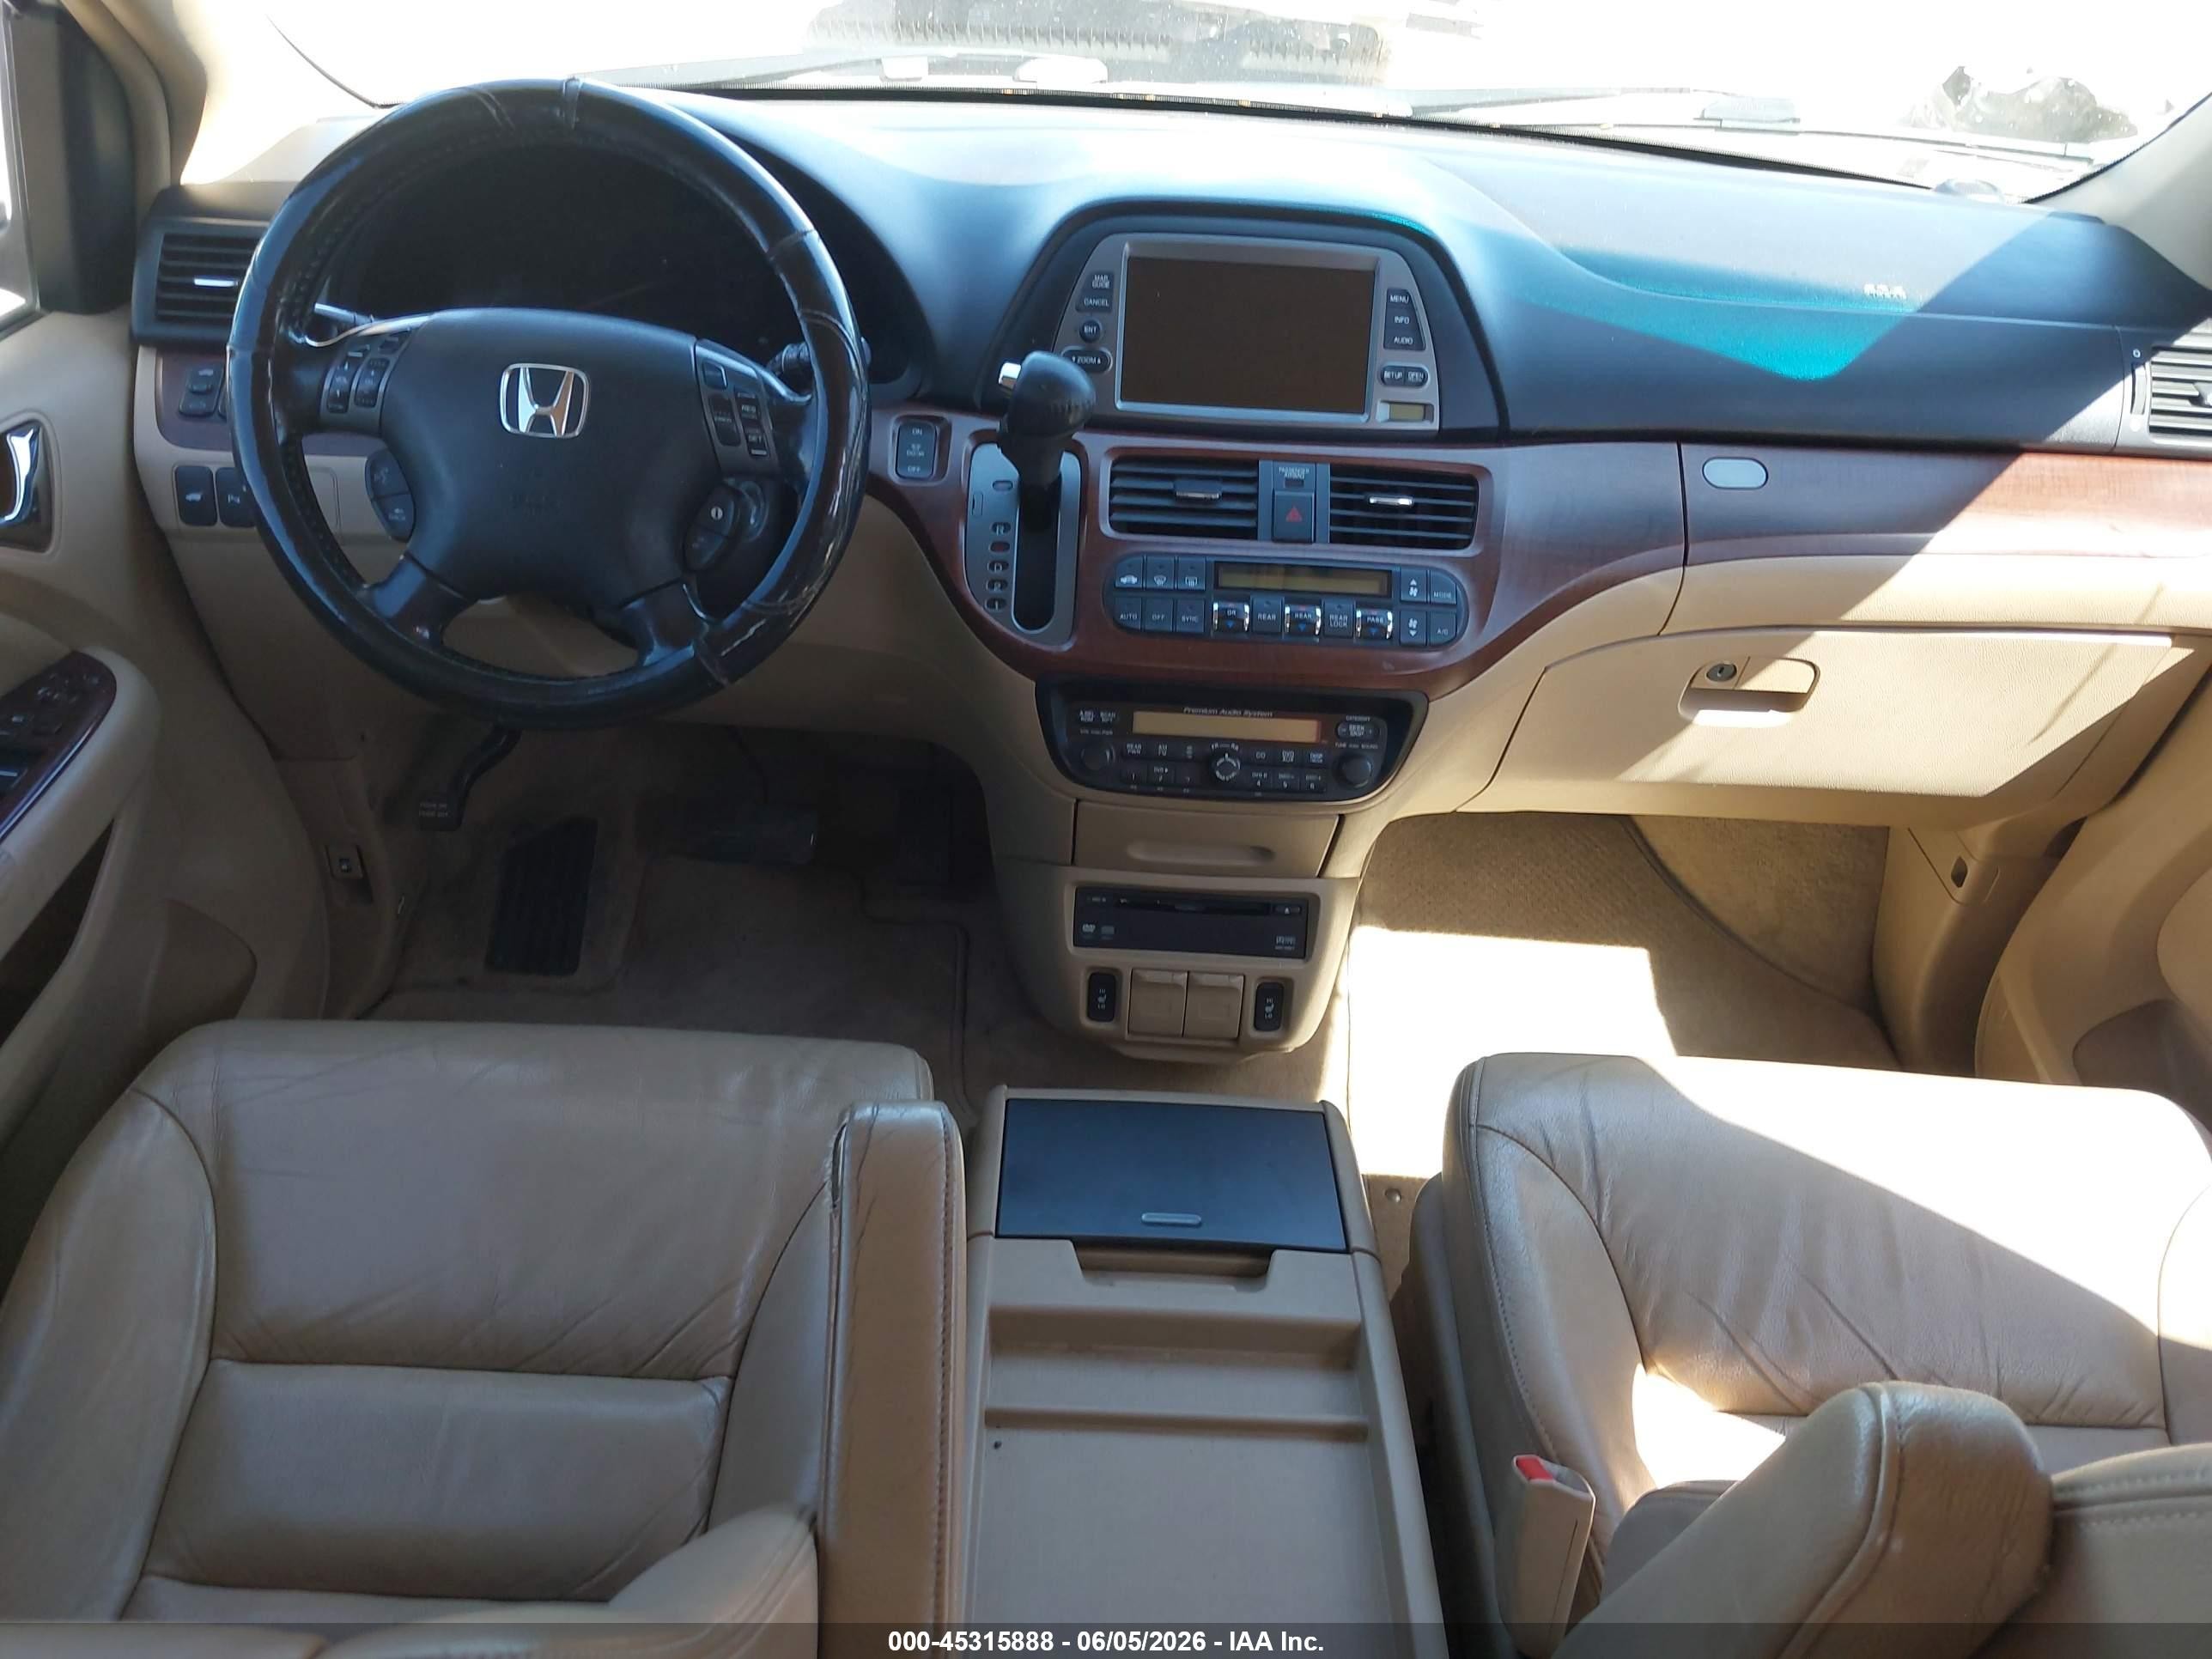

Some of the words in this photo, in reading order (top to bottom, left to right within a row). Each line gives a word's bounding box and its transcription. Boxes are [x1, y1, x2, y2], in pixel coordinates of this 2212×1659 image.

[1084, 298, 1109, 307] CANCEL
[1389, 295, 1409, 303] MENU
[1395, 315, 1409, 325] INFO
[1084, 325, 1097, 334] ENT
[1394, 336, 1413, 345] AUDIO
[1076, 356, 1097, 365] ZOOM
[996, 525, 1005, 536] R
[1182, 615, 1198, 623] SYNC
[1243, 709, 1273, 718] System
